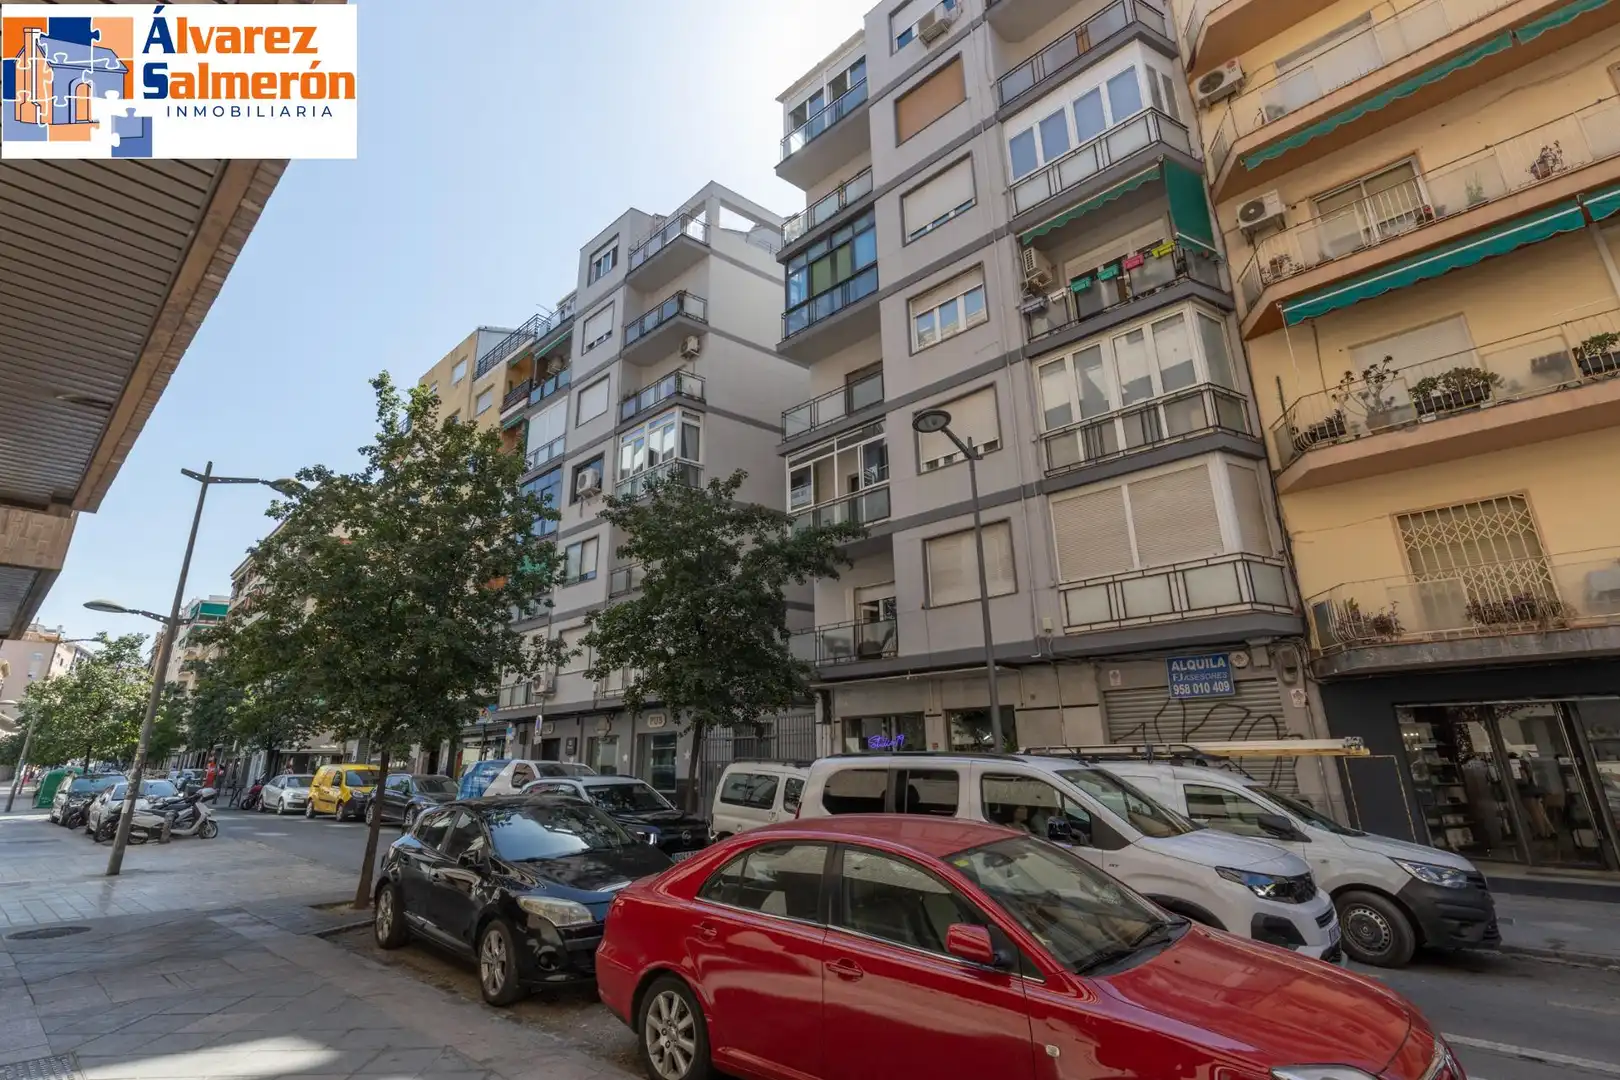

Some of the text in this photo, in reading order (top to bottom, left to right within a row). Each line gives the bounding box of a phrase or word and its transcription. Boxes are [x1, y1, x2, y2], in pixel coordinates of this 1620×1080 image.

[1171, 657, 1226, 671] ALQUILA
[1173, 681, 1230, 695] 958 010 409
